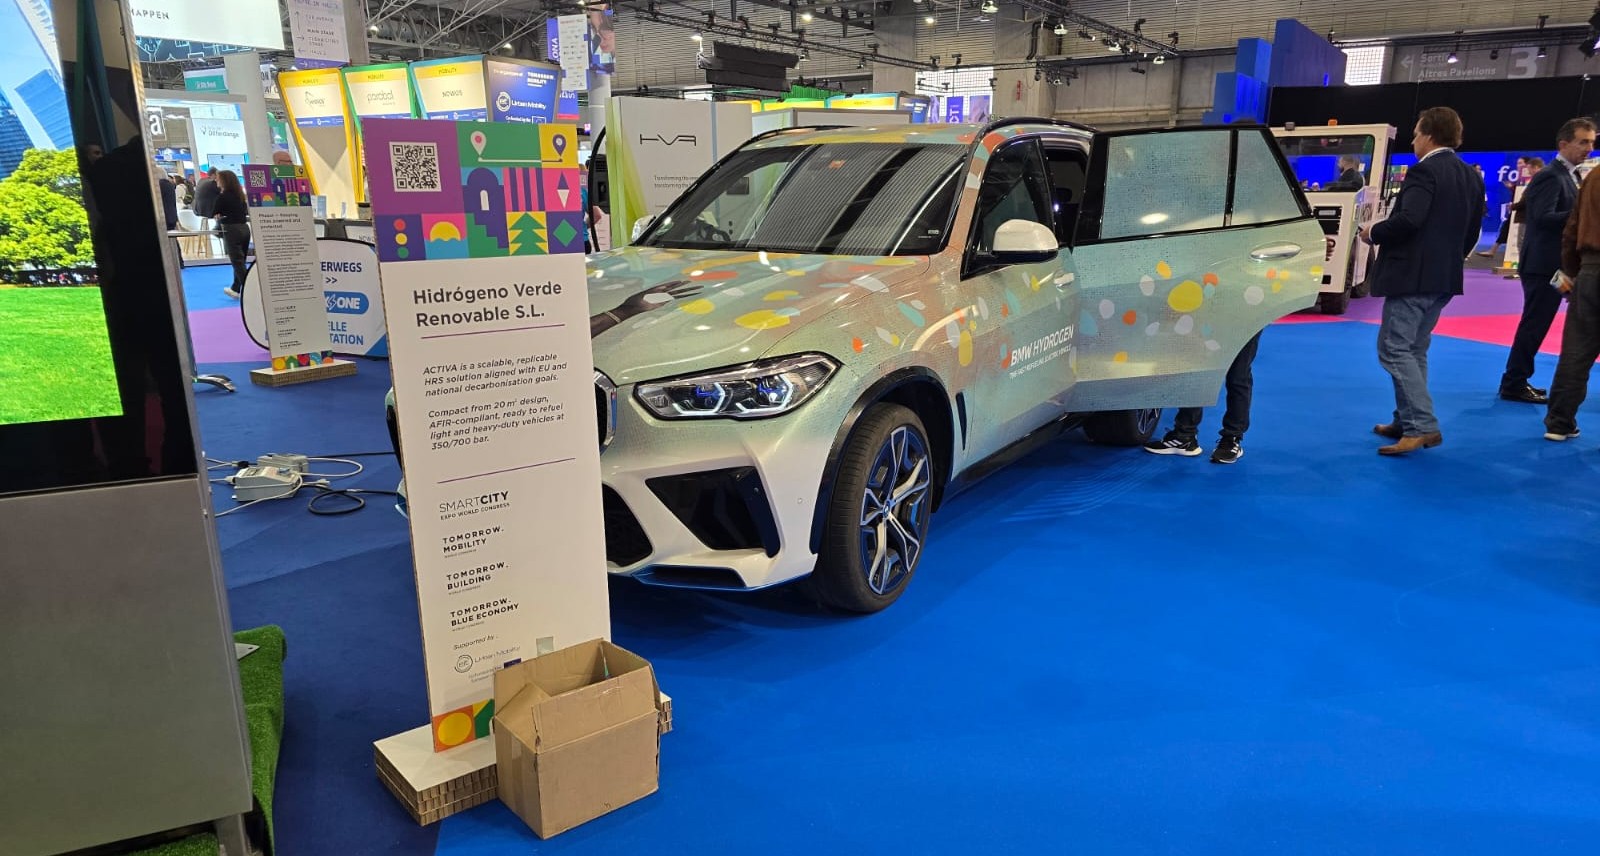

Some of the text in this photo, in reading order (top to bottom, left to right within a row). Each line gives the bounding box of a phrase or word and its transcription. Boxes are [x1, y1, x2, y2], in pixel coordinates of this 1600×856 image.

[1507, 47, 1538, 79] 3
[1498, 166, 1520, 182] fo
[320, 262, 362, 272] ERWEGS
[413, 281, 562, 305] Hidrógeno Verde
[416, 304, 545, 328] Renovable S.L.
[1010, 324, 1074, 367] BMW HYDROGEN
[423, 364, 458, 375] ACTIVA
[460, 362, 468, 371] is
[477, 358, 514, 370] scalable,
[516, 353, 558, 367] replicable
[424, 362, 568, 386] HRS solution aligned with EU and
[425, 374, 559, 398] national decarbonisation goals.
[428, 406, 469, 418] Compact
[470, 402, 492, 412] from
[494, 402, 506, 410] 20
[520, 395, 550, 406] design,
[429, 413, 500, 430] AFIR-compliant,
[502, 408, 527, 419] ready
[539, 403, 564, 414] refuel
[430, 413, 564, 440] light and heavy-duty vehicles at
[432, 434, 490, 450] 350/700 bar.
[440, 490, 508, 512] SMARTCITY
[457, 508, 480, 518] WORLD
[480, 502, 510, 512] CONGRESS
[442, 526, 504, 544] TOMORROW.
[444, 538, 486, 554] MOBILITY
[446, 562, 509, 581] TOMORROW.
[448, 574, 492, 590] BUILDING
[450, 598, 512, 618] TOMORROW.
[452, 615, 474, 626] BLUE
[476, 602, 520, 620] ECONOMY
[454, 636, 486, 650] Supported
